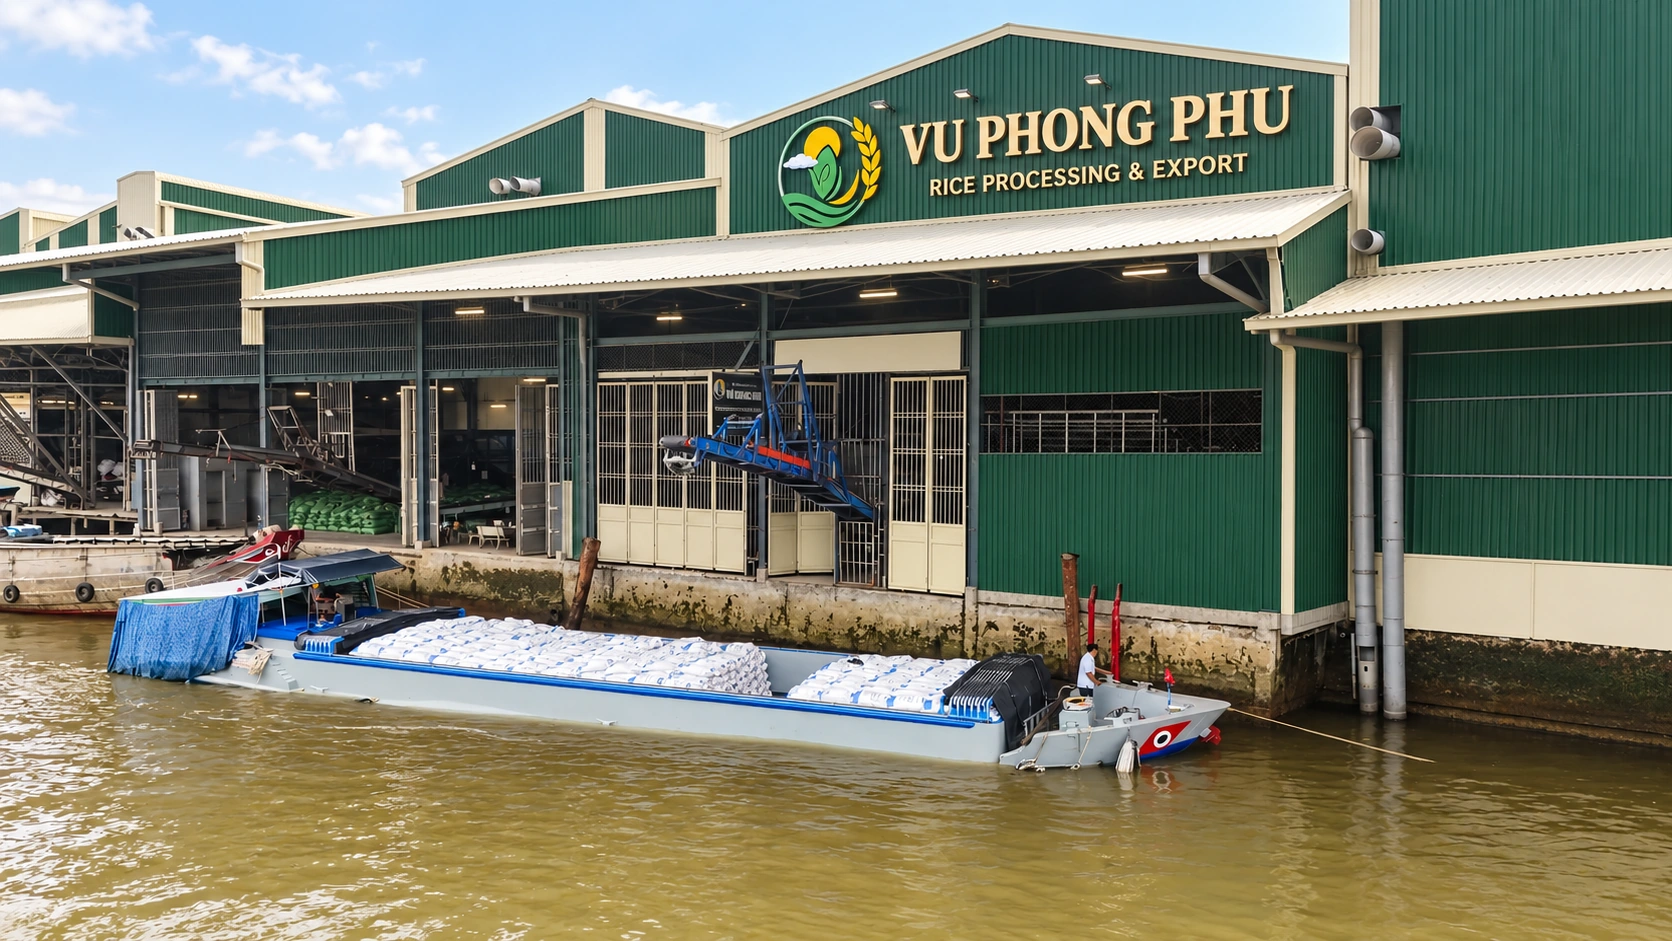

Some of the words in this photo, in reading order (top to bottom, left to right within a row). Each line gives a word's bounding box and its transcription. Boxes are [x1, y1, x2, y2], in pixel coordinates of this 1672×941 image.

[899, 118, 965, 165] VU
[976, 99, 1155, 159] PHONG
[1169, 84, 1294, 142] PHU
[929, 175, 976, 197] RICE
[982, 163, 1121, 193] PROCESSING
[1128, 162, 1145, 181] &
[1152, 152, 1248, 179] EXPORT
